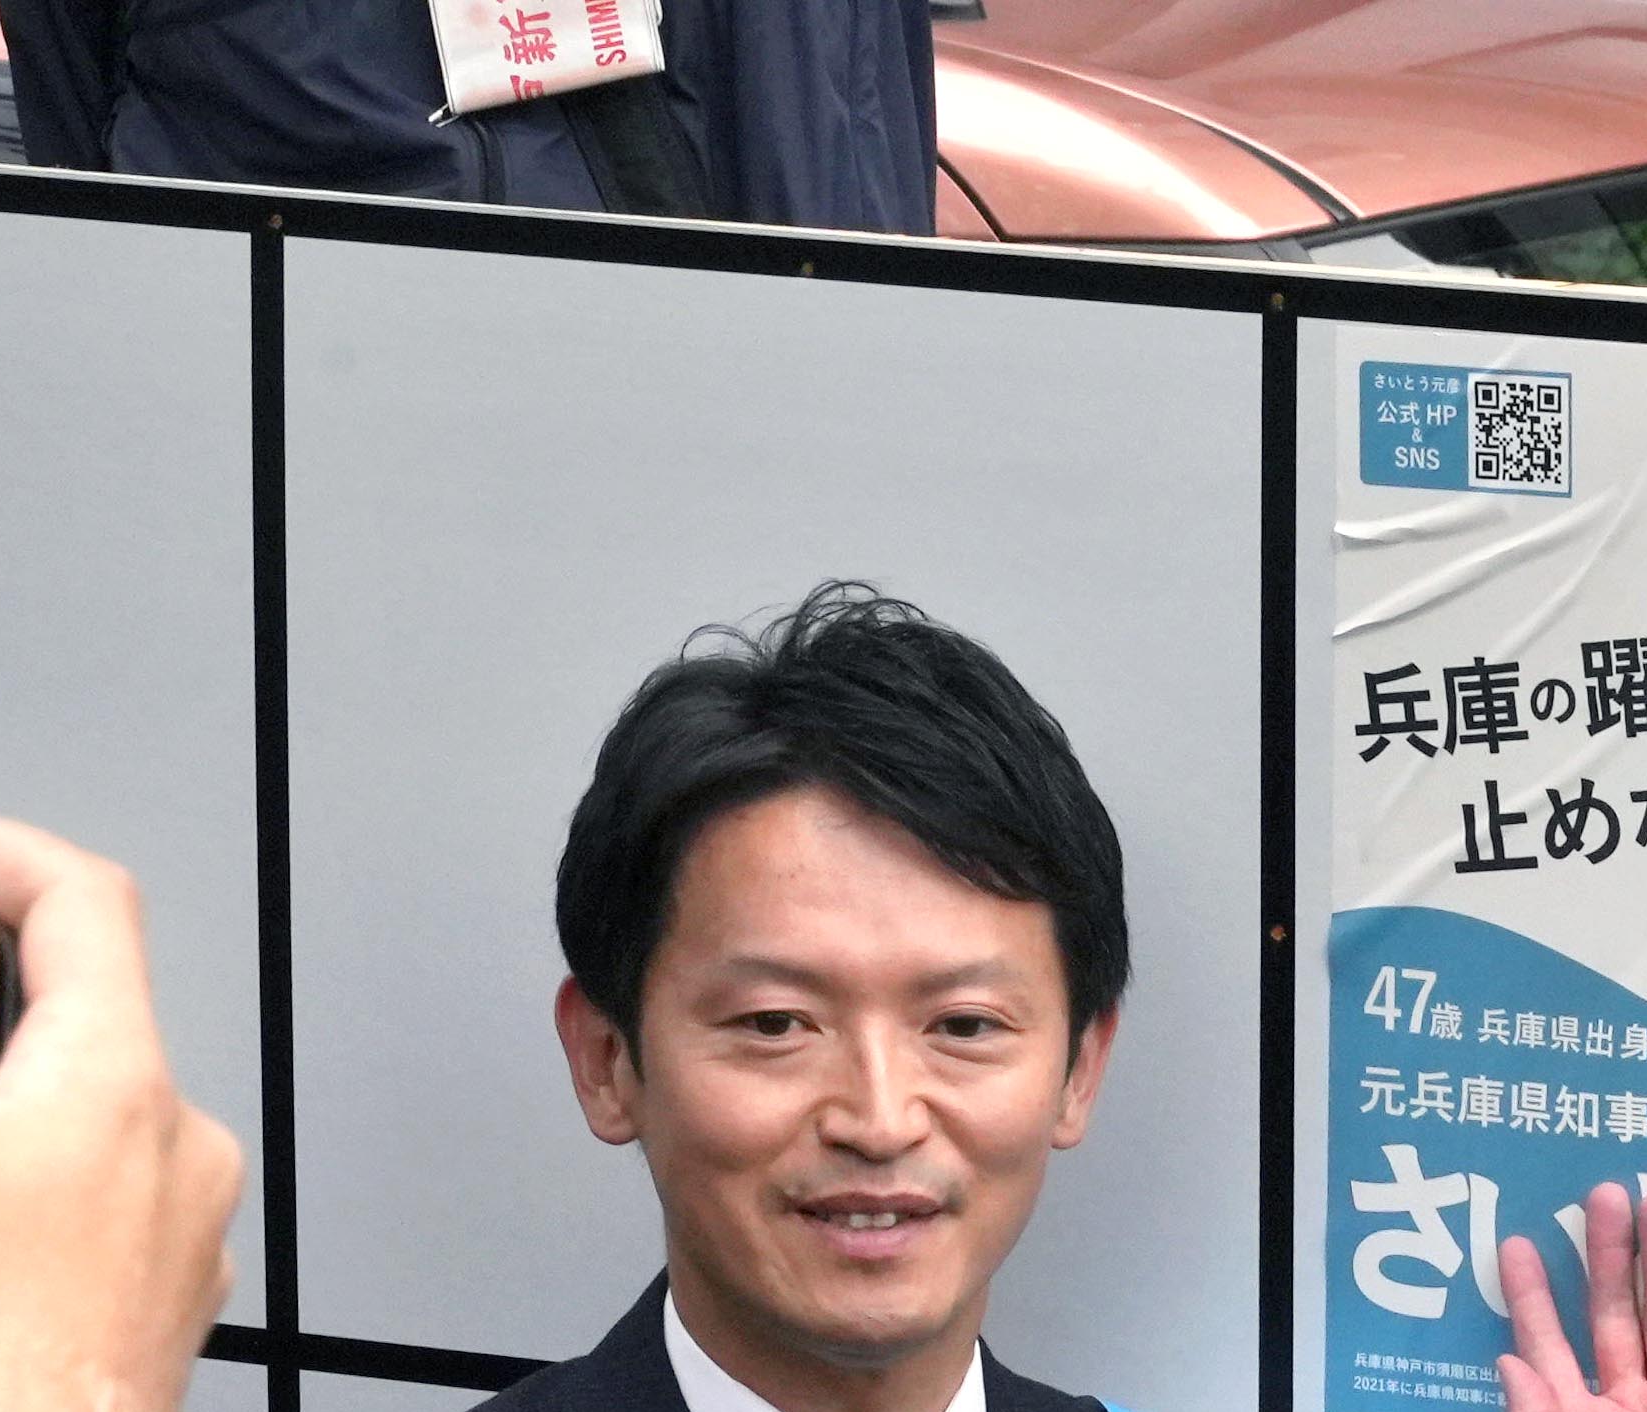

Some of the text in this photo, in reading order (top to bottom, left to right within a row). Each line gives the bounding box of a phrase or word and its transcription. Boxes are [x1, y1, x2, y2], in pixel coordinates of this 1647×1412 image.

[584, 0, 627, 67] SHIM
[496, 0, 557, 102] 戸新
[1374, 373, 1461, 394] さいとう元彦
[1377, 400, 1458, 426] 公式 HP
[1411, 427, 1423, 443] &
[1394, 446, 1441, 471] SNS
[1363, 964, 1464, 1042] 47歳
